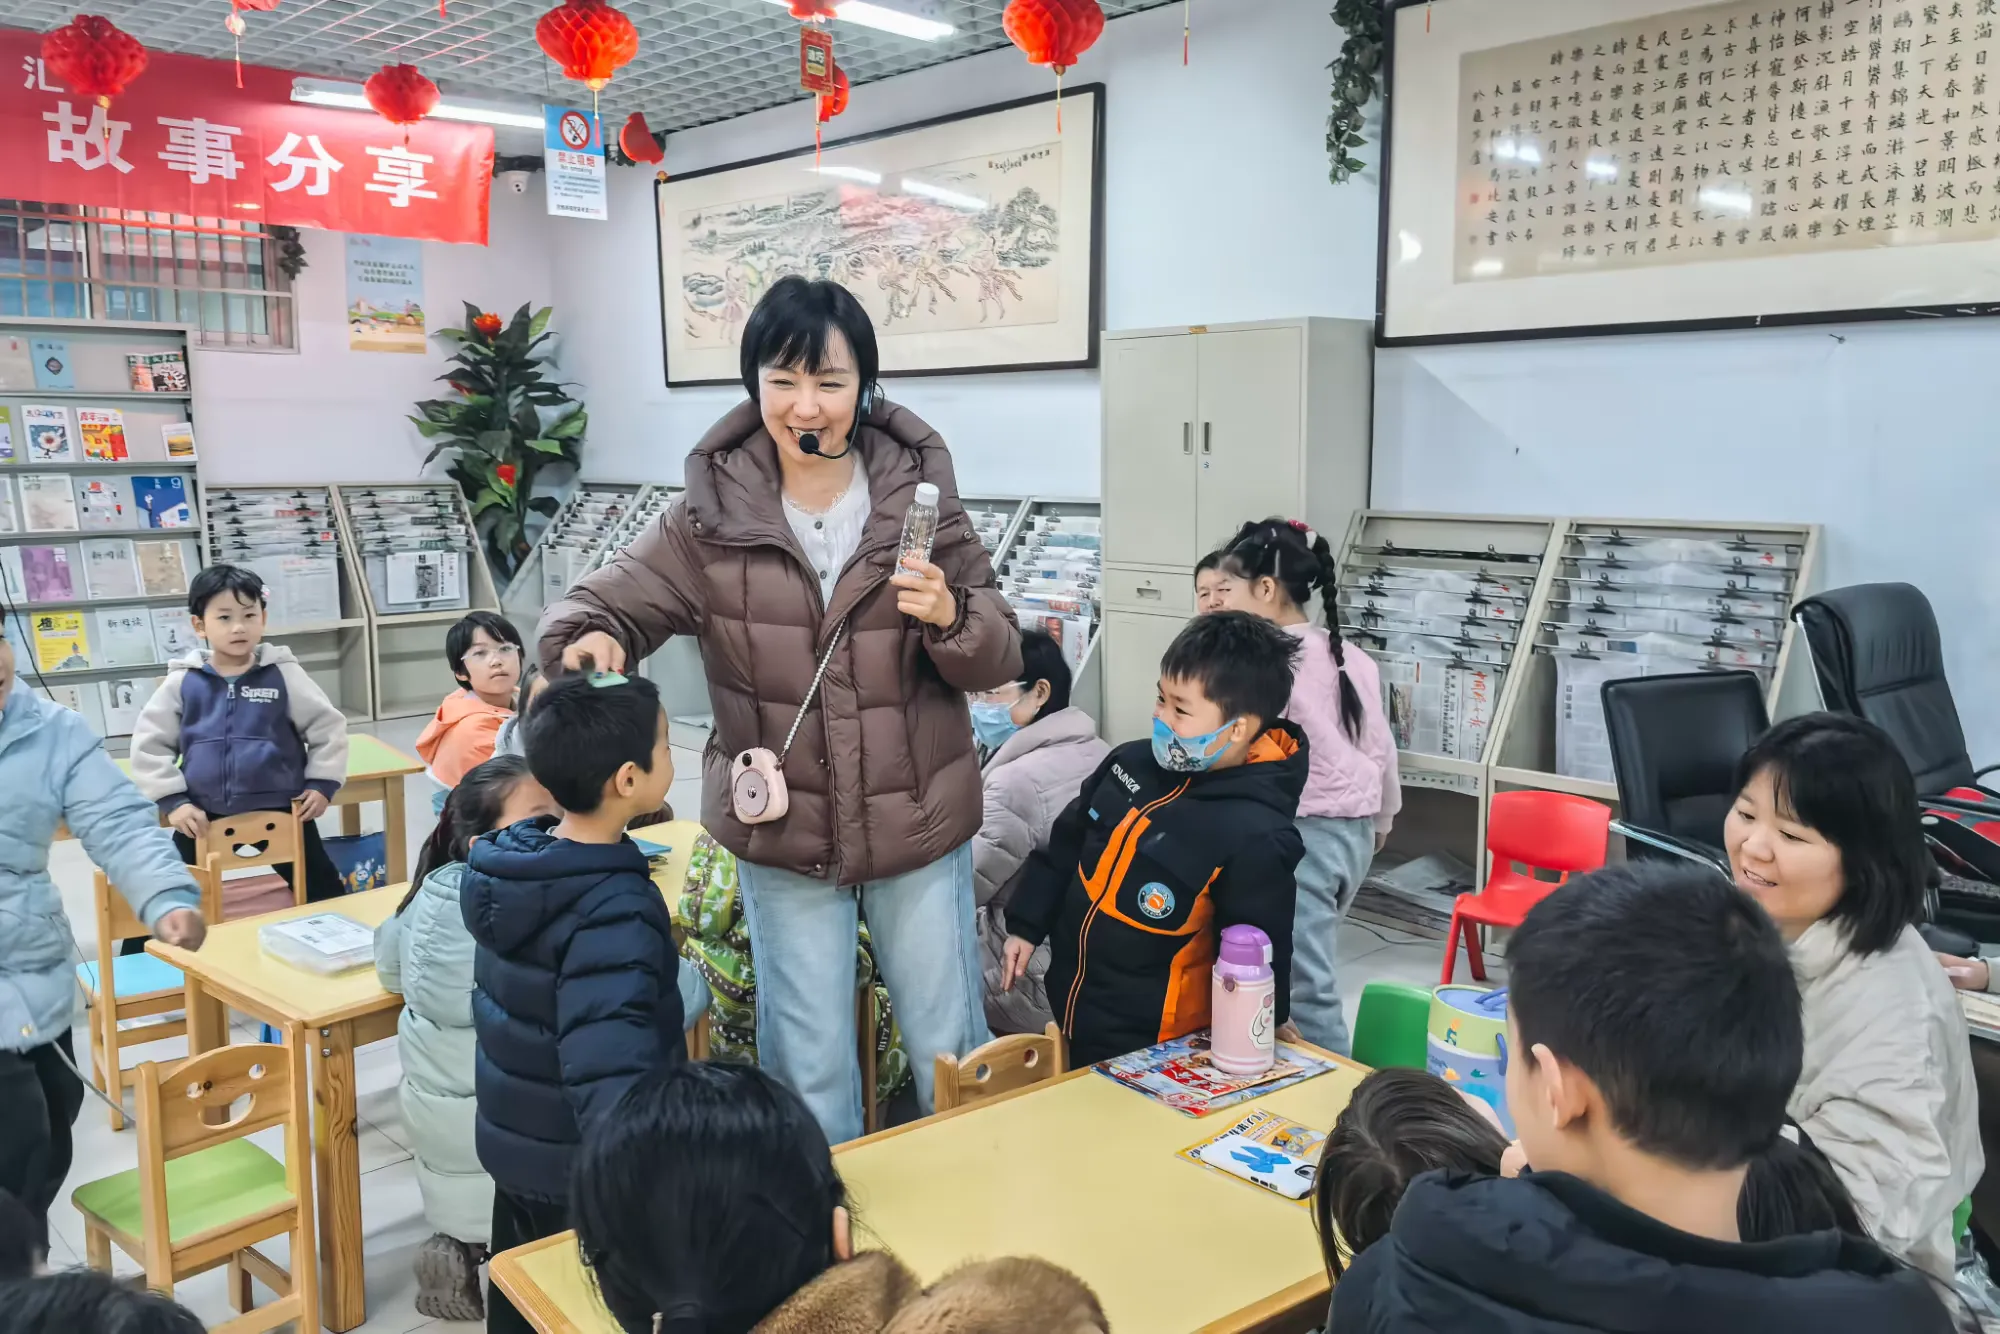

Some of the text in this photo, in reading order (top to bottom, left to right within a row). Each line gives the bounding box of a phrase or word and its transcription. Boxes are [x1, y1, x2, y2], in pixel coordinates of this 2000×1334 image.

[42, 100, 438, 209] 故事分享
[557, 152, 596, 168] 禁止吸烟
